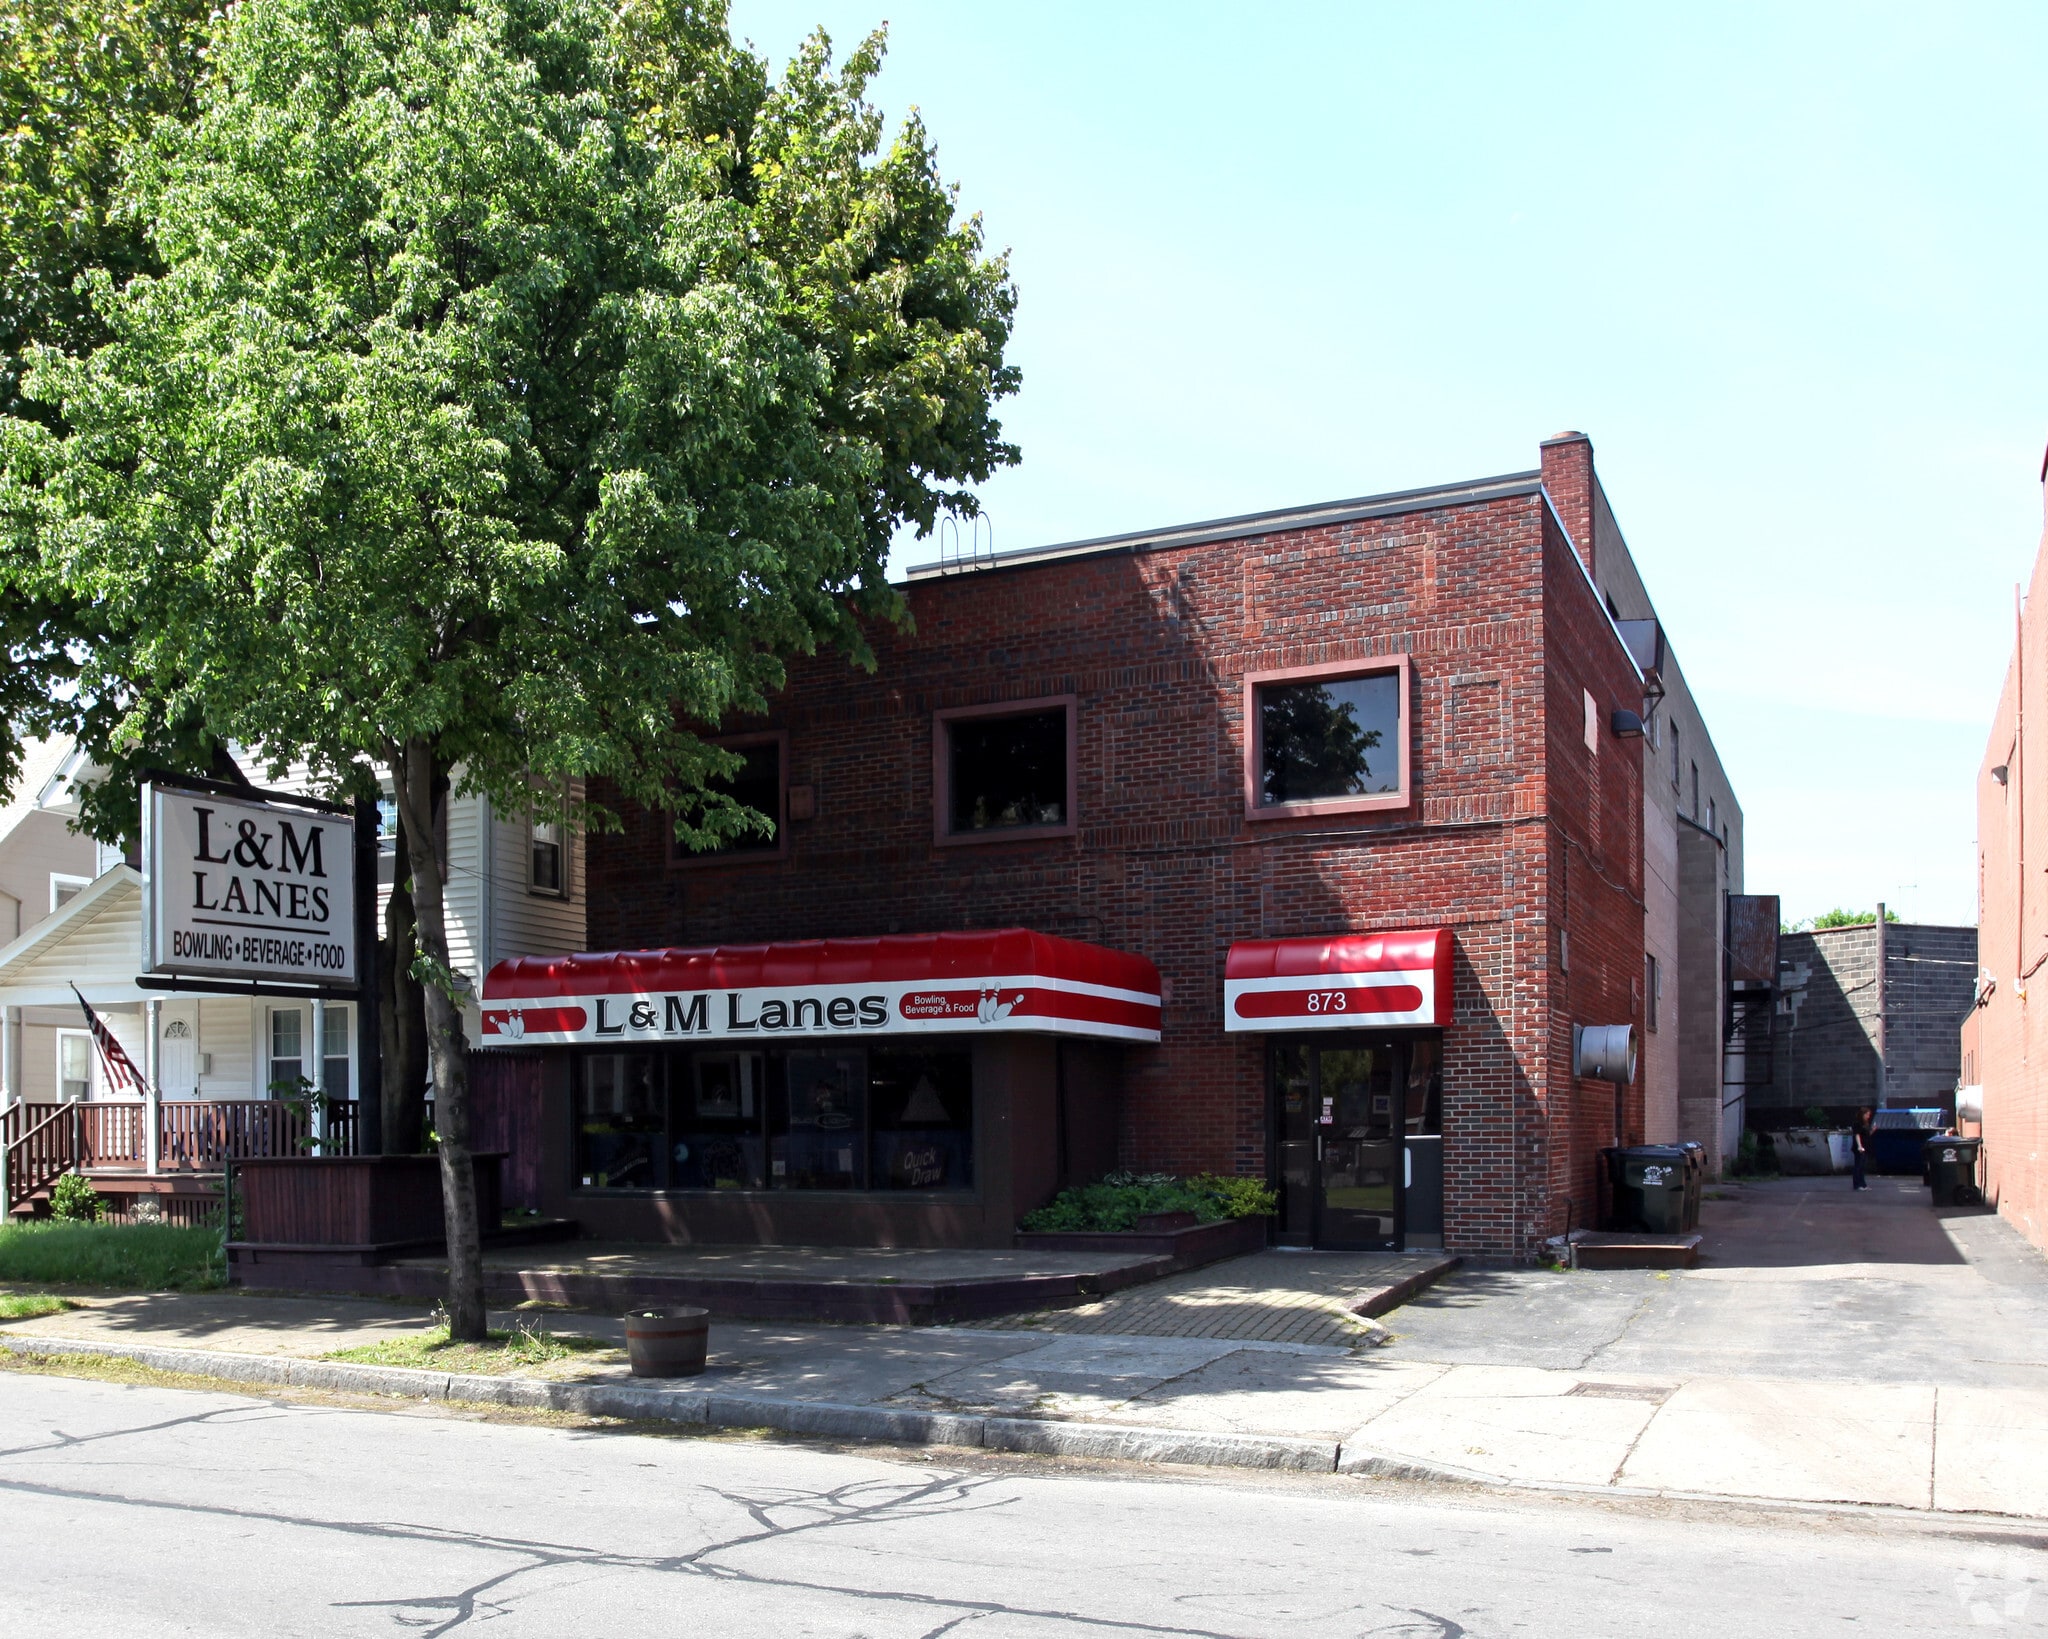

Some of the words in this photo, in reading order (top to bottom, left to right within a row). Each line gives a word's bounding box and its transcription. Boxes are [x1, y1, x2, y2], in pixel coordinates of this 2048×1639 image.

[193, 806, 327, 878] L&M
[192, 871, 329, 923] LANES
[173, 930, 233, 961] BOWLING
[243, 936, 305, 967] BEVERAGE
[314, 943, 345, 970] FOOD
[595, 993, 711, 1036] L&M
[726, 992, 889, 1033] Lanes
[905, 1004, 943, 1016] Beverage
[945, 1003, 951, 1013] &
[953, 1002, 975, 1013] Food
[1306, 991, 1347, 1012] 873
[904, 1147, 936, 1170] Quick
[911, 1165, 942, 1186] Draw
